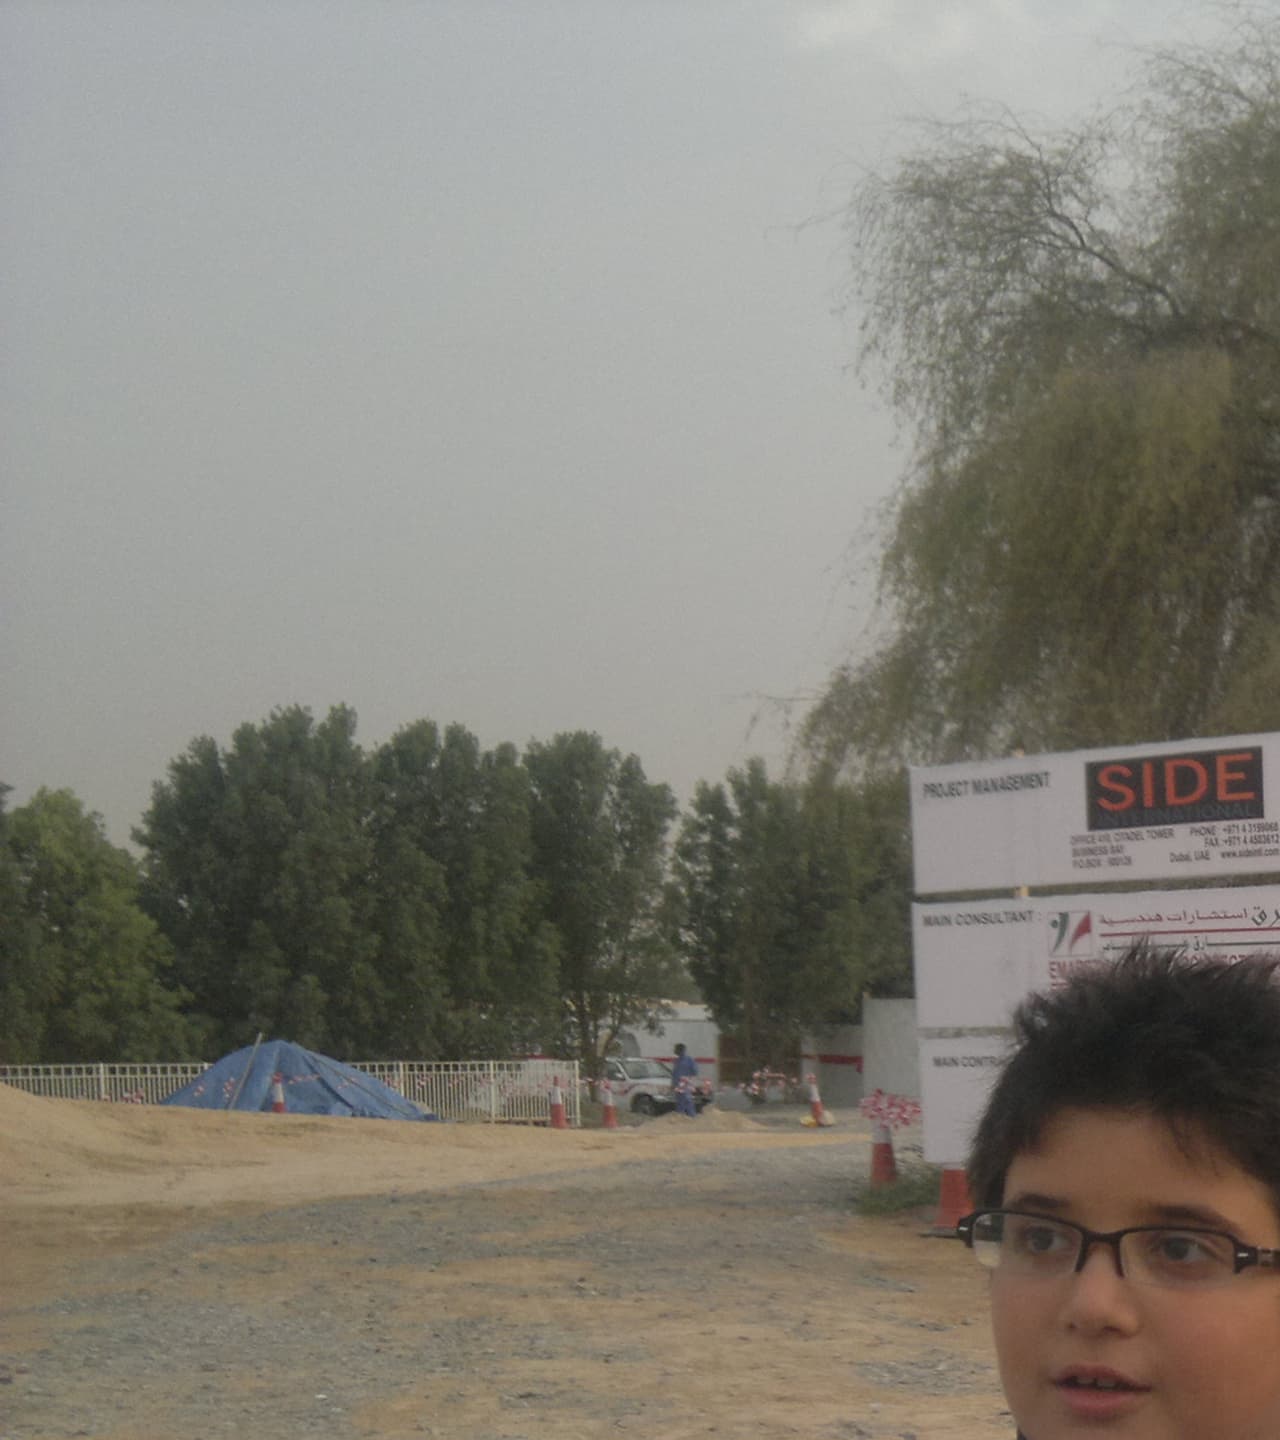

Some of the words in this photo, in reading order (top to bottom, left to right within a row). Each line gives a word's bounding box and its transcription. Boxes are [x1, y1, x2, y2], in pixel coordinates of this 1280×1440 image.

[923, 779, 969, 799] PROJECT
[971, 771, 1049, 796] MANAGEMENT
[1097, 752, 1256, 812] SIDE
[922, 915, 953, 927] MAIN
[955, 910, 1034, 926] CONSULTANT
[932, 1055, 959, 1068] MAIN
